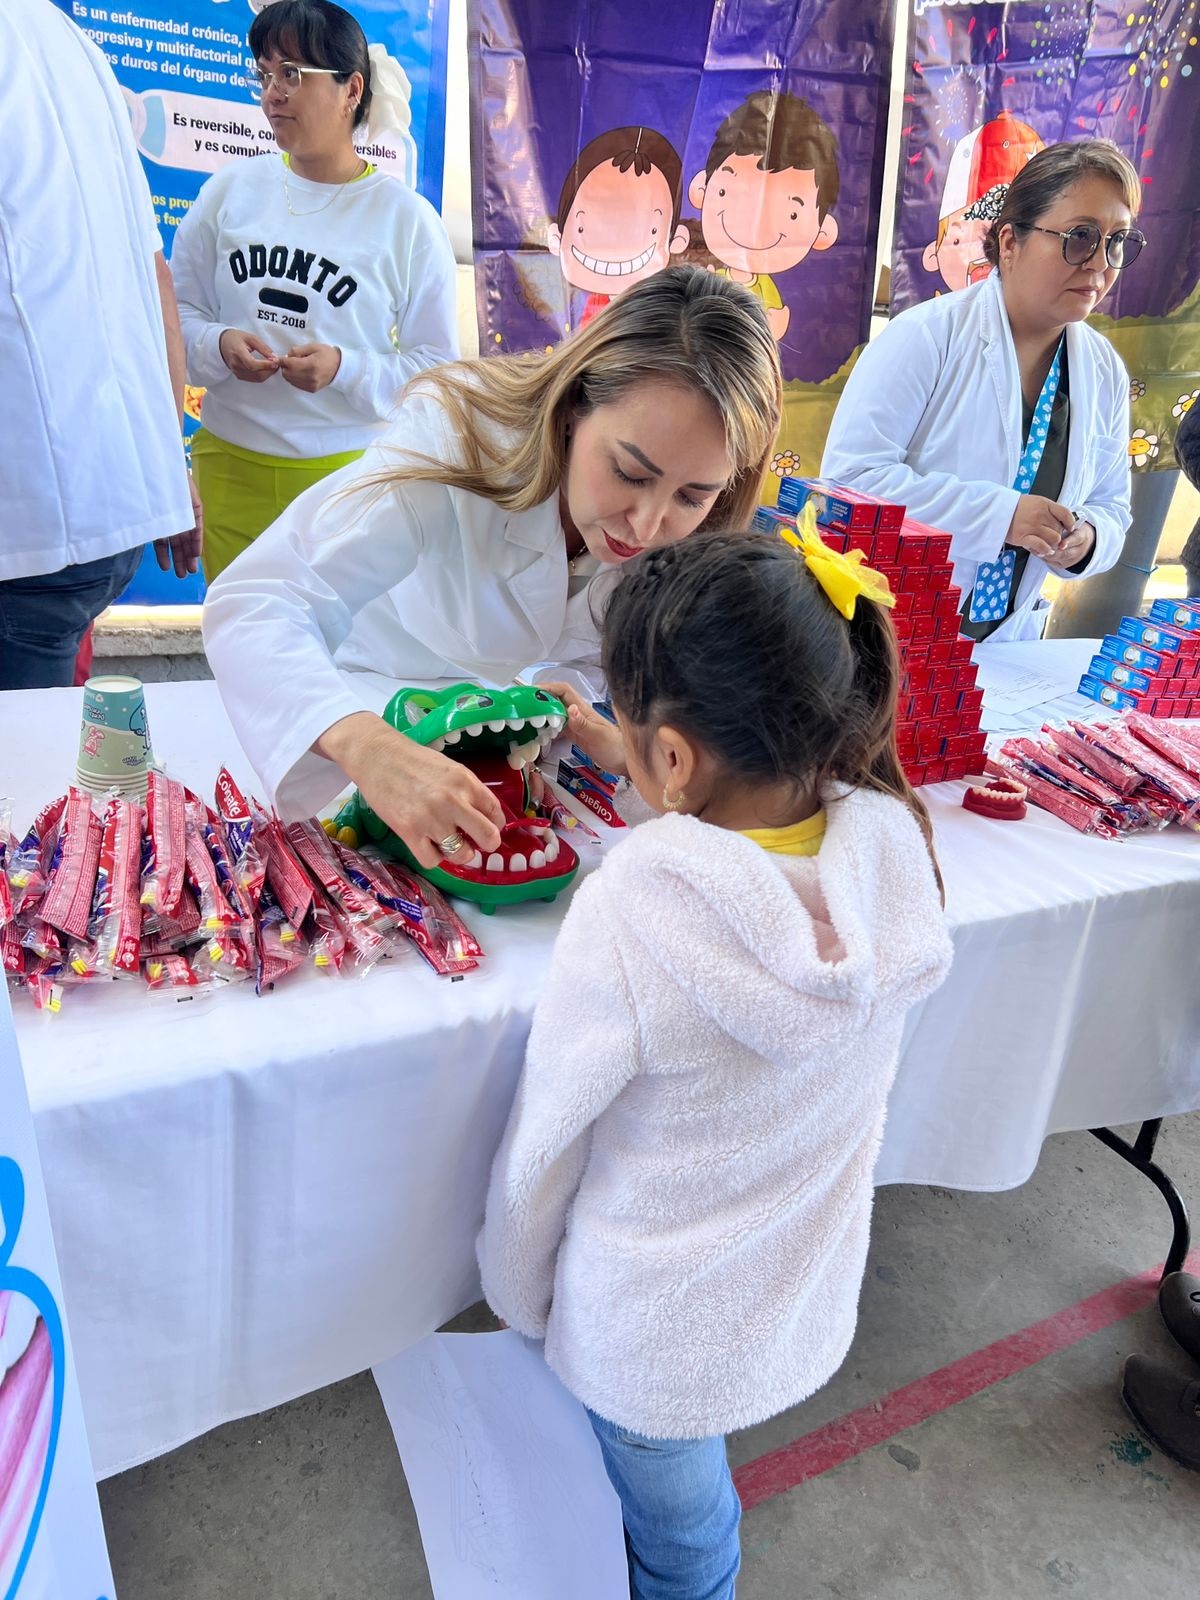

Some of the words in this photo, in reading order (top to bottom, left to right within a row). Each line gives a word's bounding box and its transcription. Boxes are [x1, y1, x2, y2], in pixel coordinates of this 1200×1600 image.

[72, 2, 87, 17] Es
[90, 8, 107, 21] un
[111, 12, 189, 36] enfermedad
[192, 26, 242, 48] crónica,
[146, 39, 153, 53] y
[156, 41, 242, 66] multifactorial
[104, 53, 118, 65] os
[121, 53, 158, 72] duros
[161, 60, 180, 77] del
[183, 64, 227, 84] órgano
[230, 72, 247, 87] de
[173, 112, 187, 127] Es
[191, 118, 255, 141] reversible,
[194, 139, 202, 152] y
[204, 141, 219, 152] es
[229, 244, 357, 307] ODONTO
[257, 309, 278, 323] EST.
[281, 315, 305, 329] 2018
[580, 791, 612, 821] Colgate
